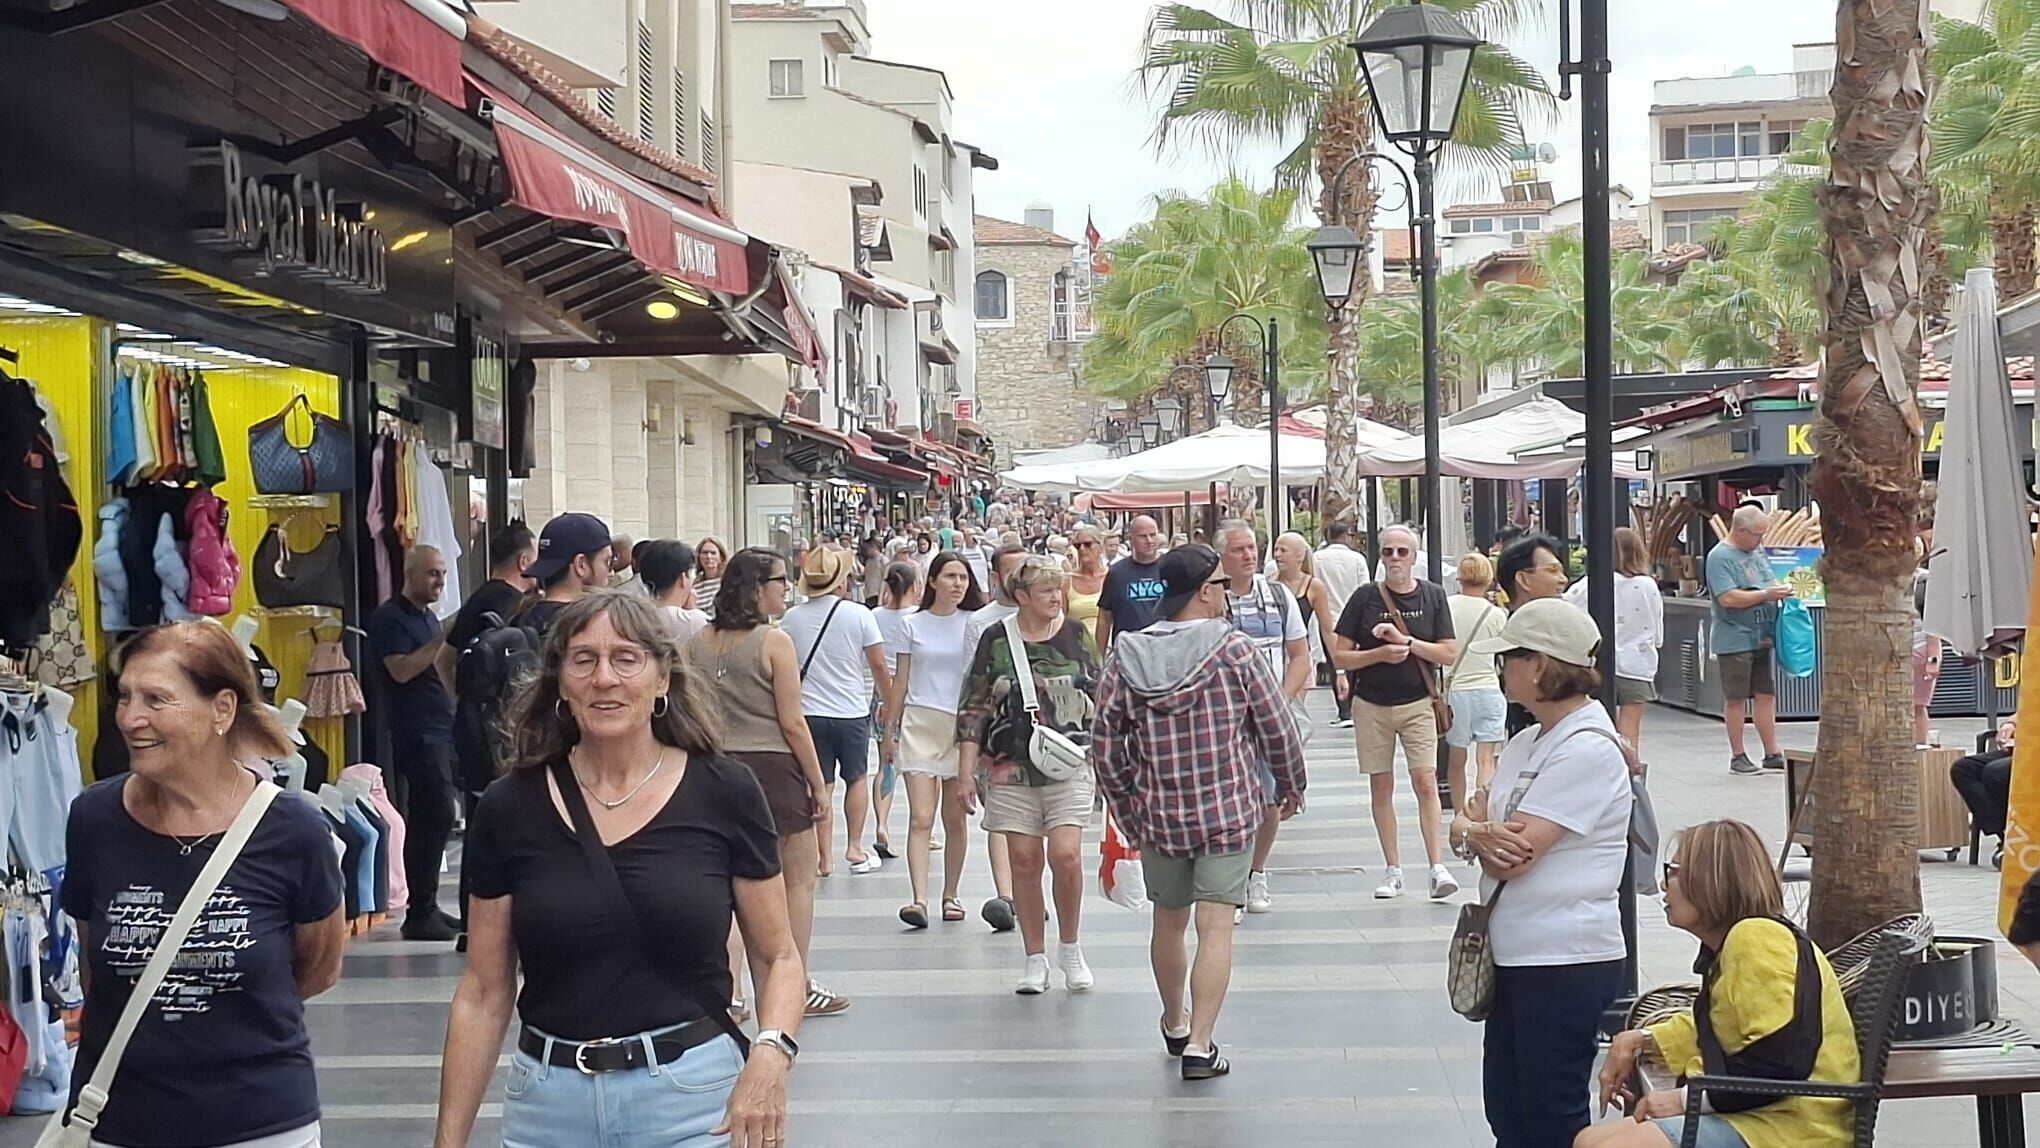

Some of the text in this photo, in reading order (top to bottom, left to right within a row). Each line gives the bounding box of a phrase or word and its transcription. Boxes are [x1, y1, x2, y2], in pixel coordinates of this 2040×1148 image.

[221, 138, 387, 291] Royal Marin
[109, 925, 160, 945] HAPPY
[208, 917, 248, 933] HAPPY
[102, 936, 158, 960] happ
